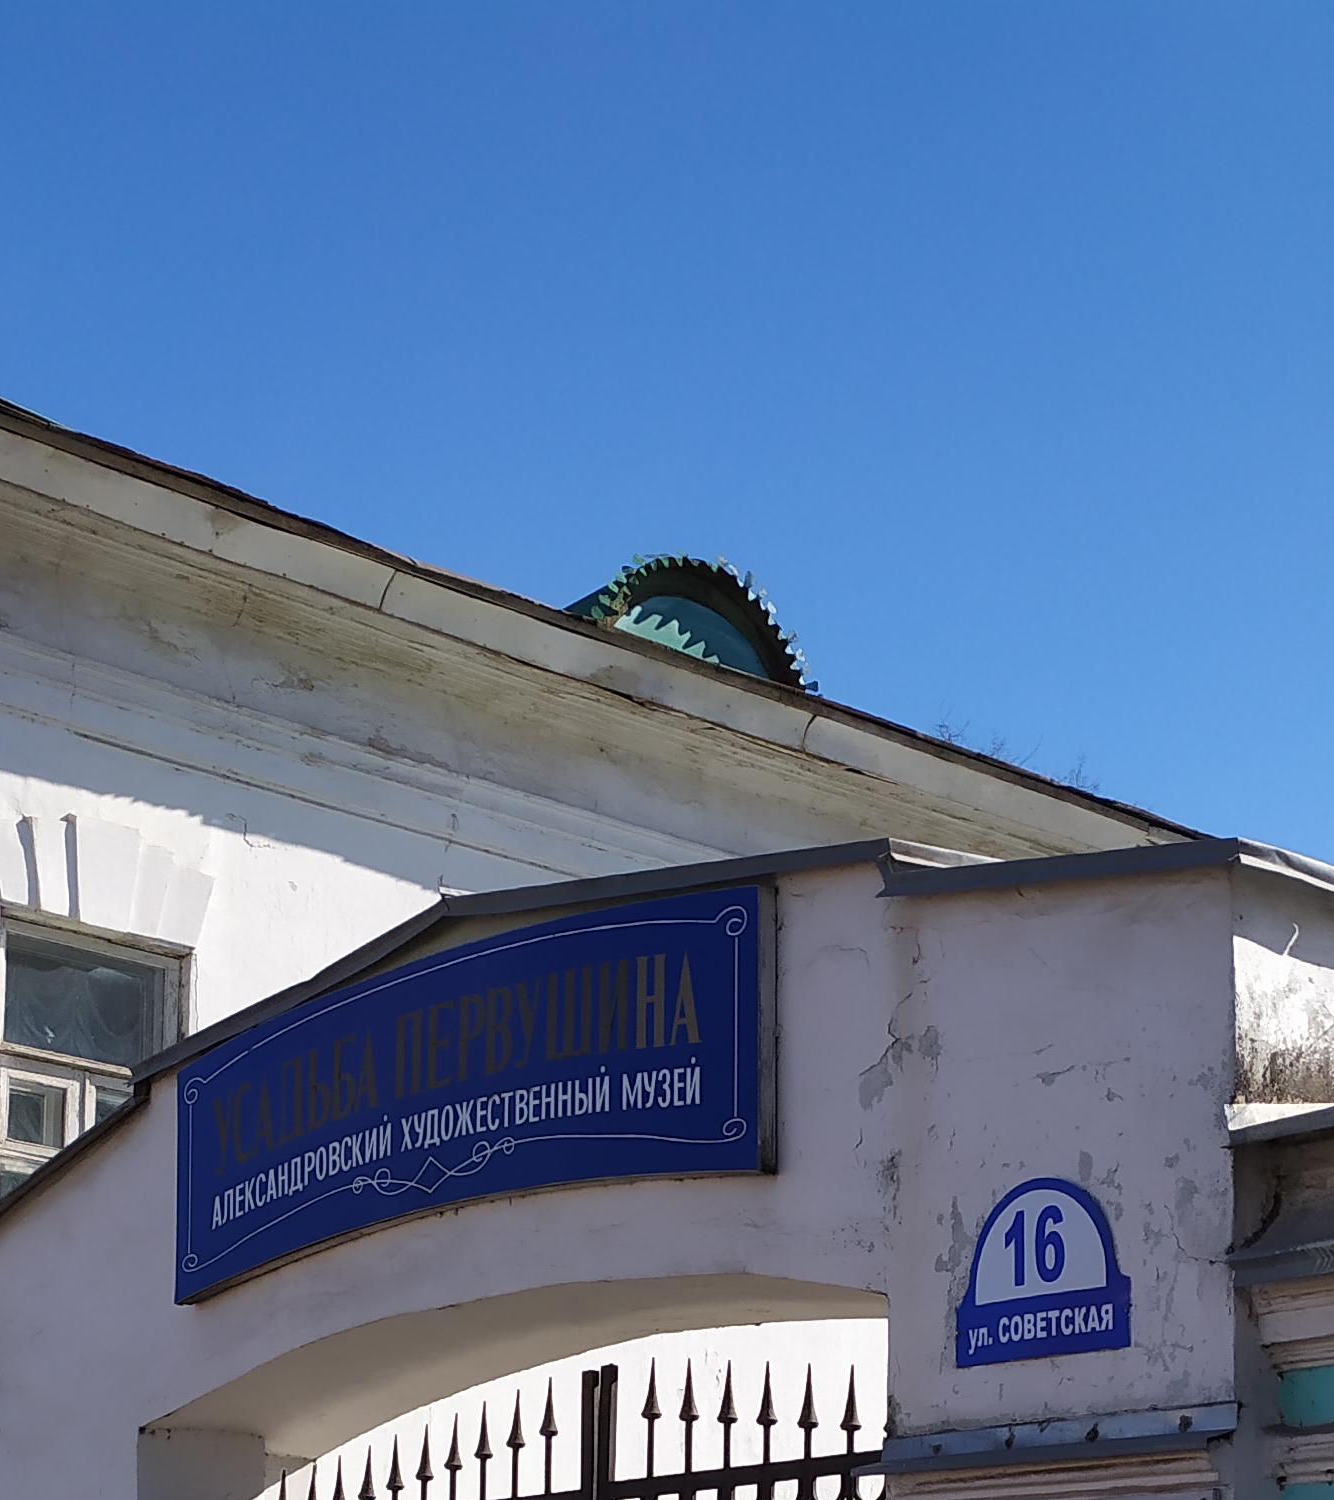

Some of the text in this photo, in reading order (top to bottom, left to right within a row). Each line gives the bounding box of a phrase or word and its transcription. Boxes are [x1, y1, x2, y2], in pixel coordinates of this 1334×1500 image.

[214, 950, 702, 1175] УСАДЬБА ПЕРВУШИНА
[211, 1056, 702, 1231] АЛЕКСАНДРОВСКИЙ ХУДОЖЕСТВЕННЫЙ МУЗЕЙ
[1004, 1205, 1065, 1287] 16
[968, 1303, 1114, 1354] ул. СОВЕТСКАЯ
